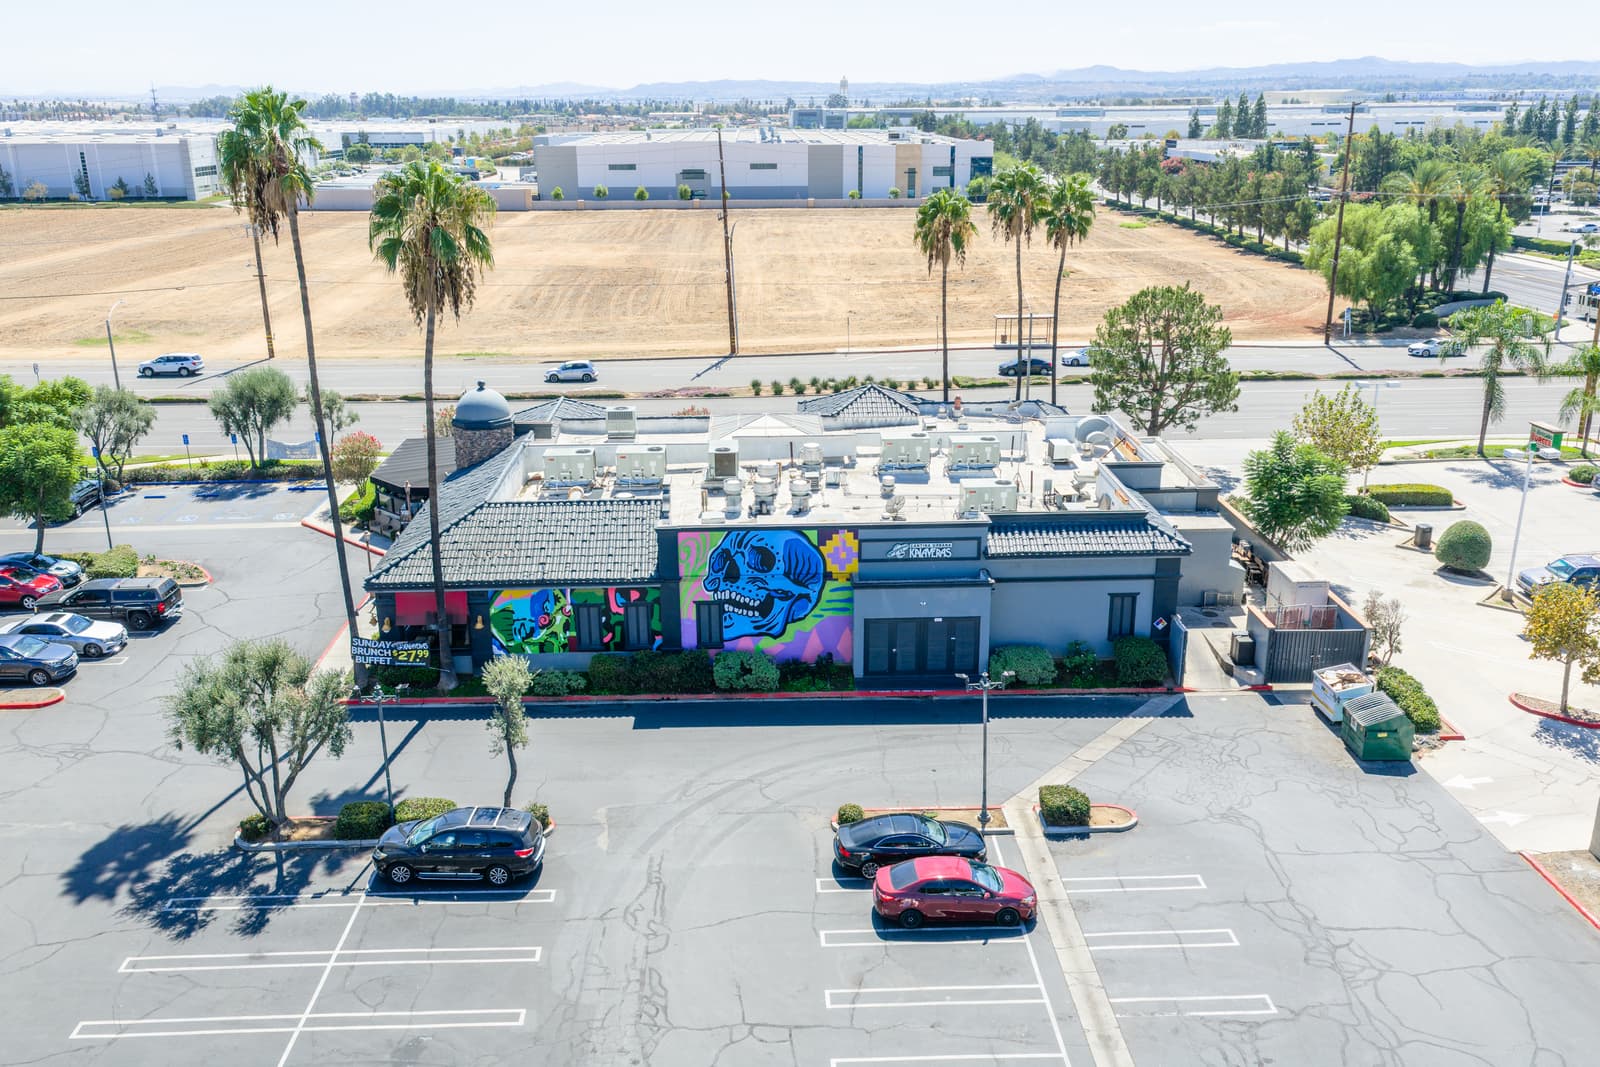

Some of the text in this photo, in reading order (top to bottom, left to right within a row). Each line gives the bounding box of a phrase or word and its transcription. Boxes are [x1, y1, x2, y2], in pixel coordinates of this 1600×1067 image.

[910, 548, 952, 558] KALAVERAS
[352, 638, 392, 649] SUNDAY
[351, 646, 392, 657] BRUNCH
[392, 649, 429, 662] $27.99
[355, 655, 392, 665] BUFFET
